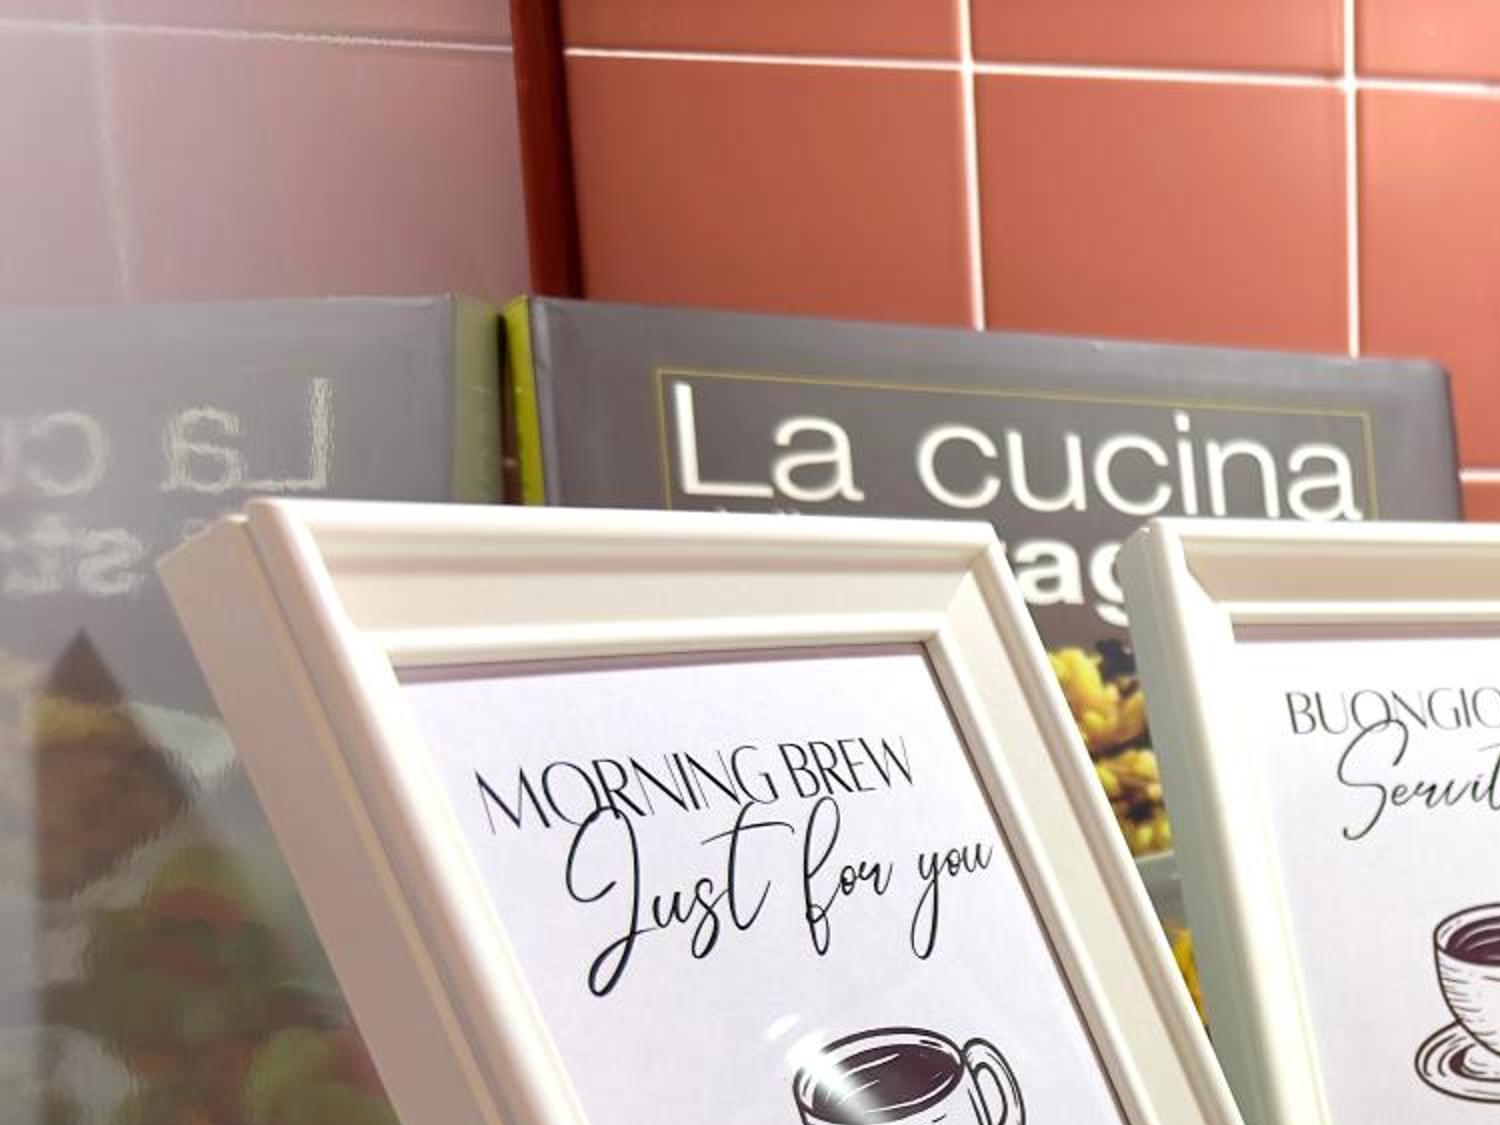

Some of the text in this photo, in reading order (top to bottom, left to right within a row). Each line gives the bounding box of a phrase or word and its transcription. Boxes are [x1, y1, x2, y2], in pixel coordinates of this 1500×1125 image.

[673, 382, 1365, 521] La cucina
[475, 735, 914, 835] MORNING BREW
[565, 796, 993, 998] Just for you
